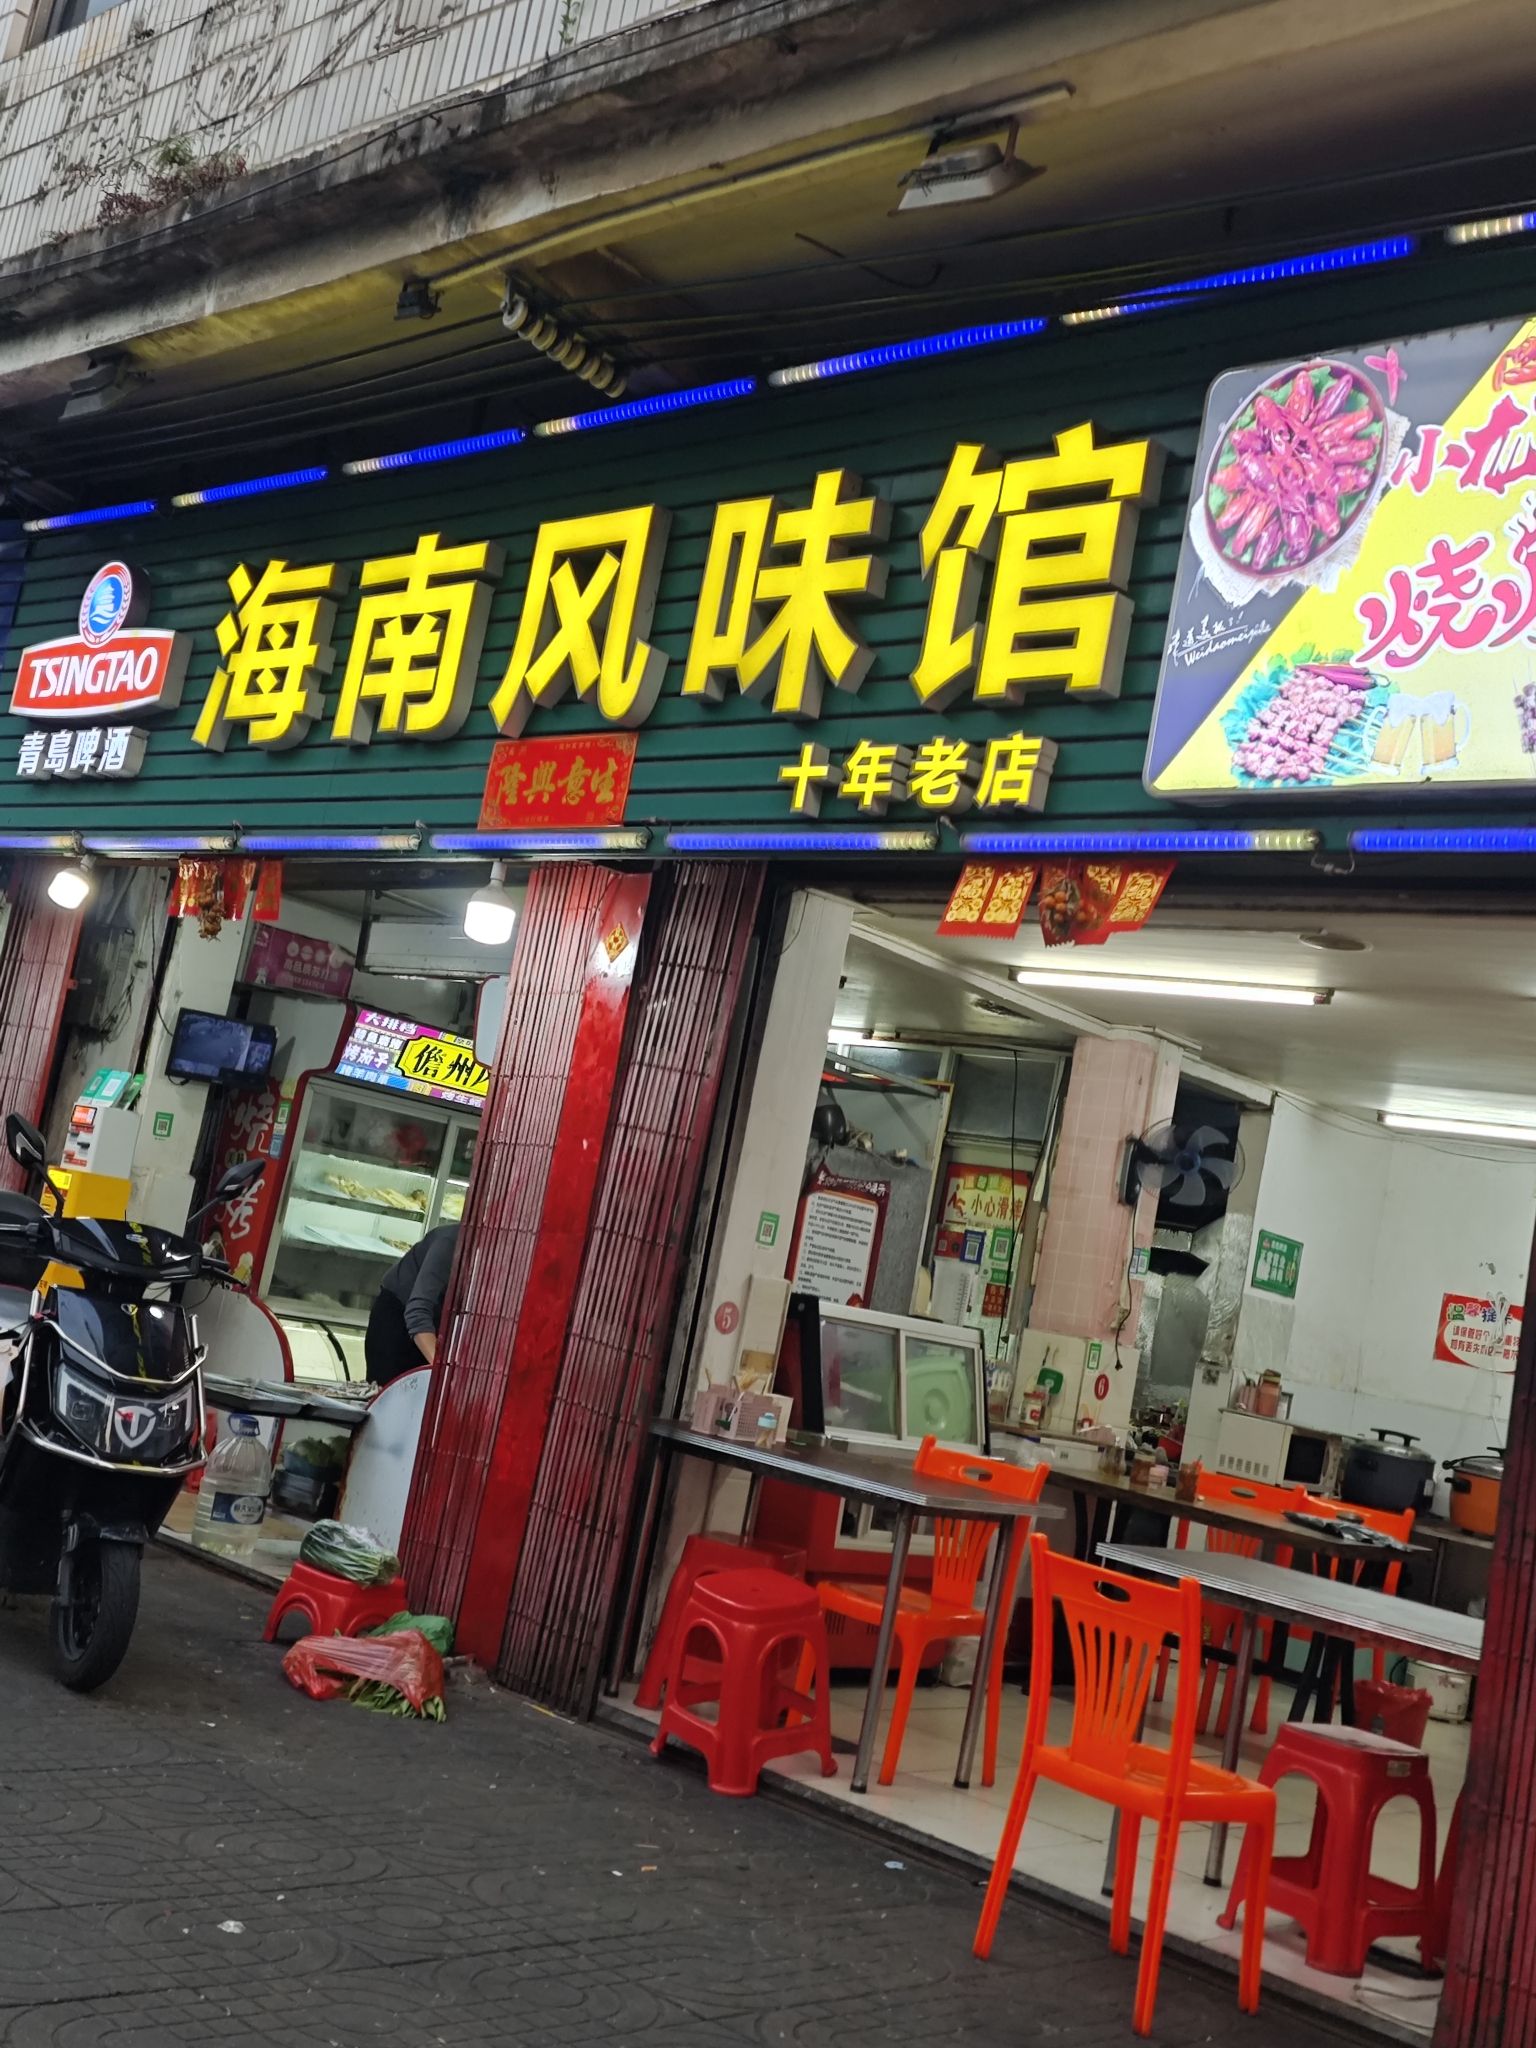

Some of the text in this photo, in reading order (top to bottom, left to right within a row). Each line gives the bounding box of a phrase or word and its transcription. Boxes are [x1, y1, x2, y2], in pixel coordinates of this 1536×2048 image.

[191, 420, 1150, 749] 海南风味馆
[29, 645, 159, 700] TSINGTAO
[779, 731, 1045, 811] 十年老店
[364, 1011, 418, 1035] 大排档
[721, 1307, 732, 1329] 5
[1097, 1377, 1105, 1398] 6
